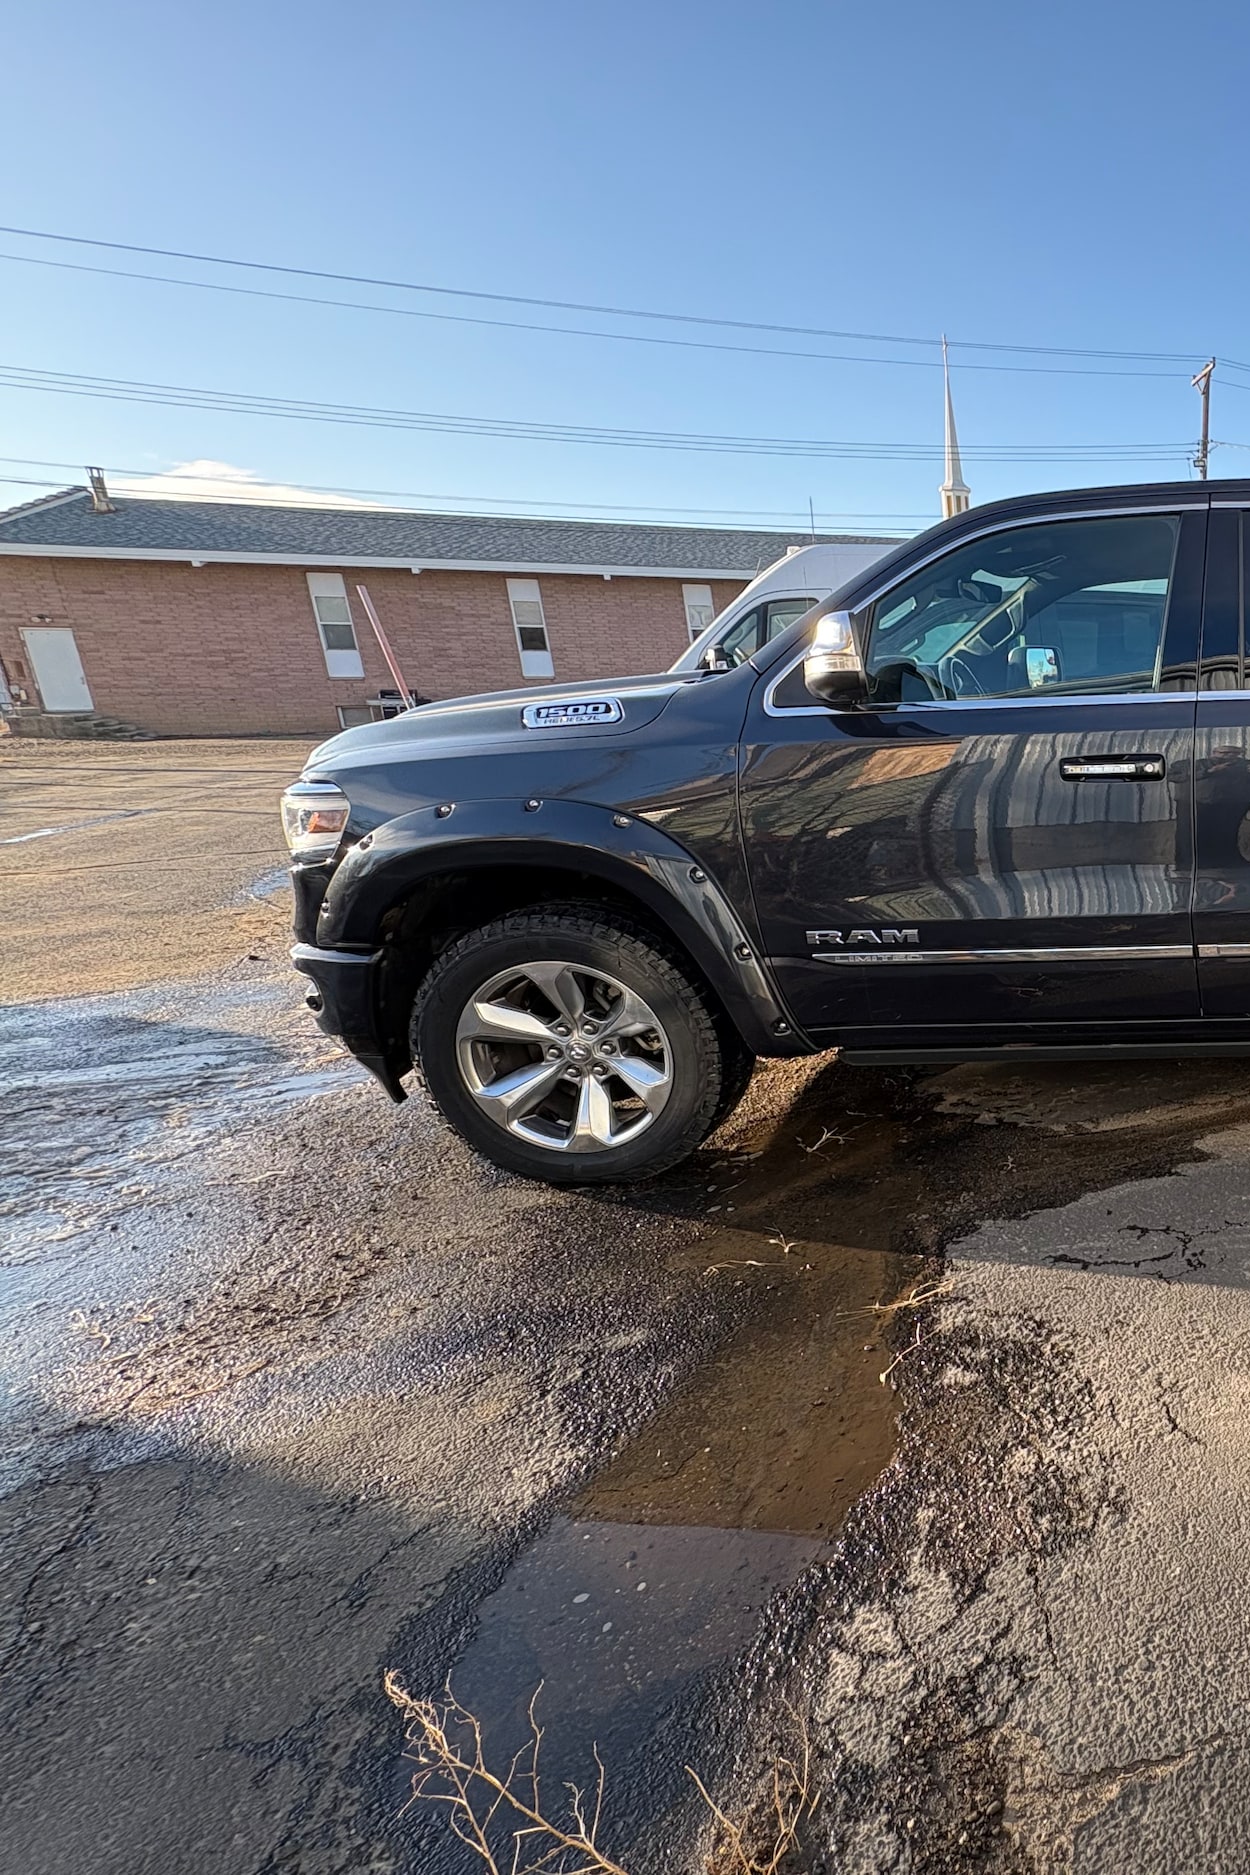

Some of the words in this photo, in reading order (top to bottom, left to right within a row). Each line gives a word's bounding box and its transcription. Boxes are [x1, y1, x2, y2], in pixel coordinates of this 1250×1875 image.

[539, 704, 606, 718] 1500
[806, 929, 920, 944] RAM
[834, 954, 923, 963] LIMITED
